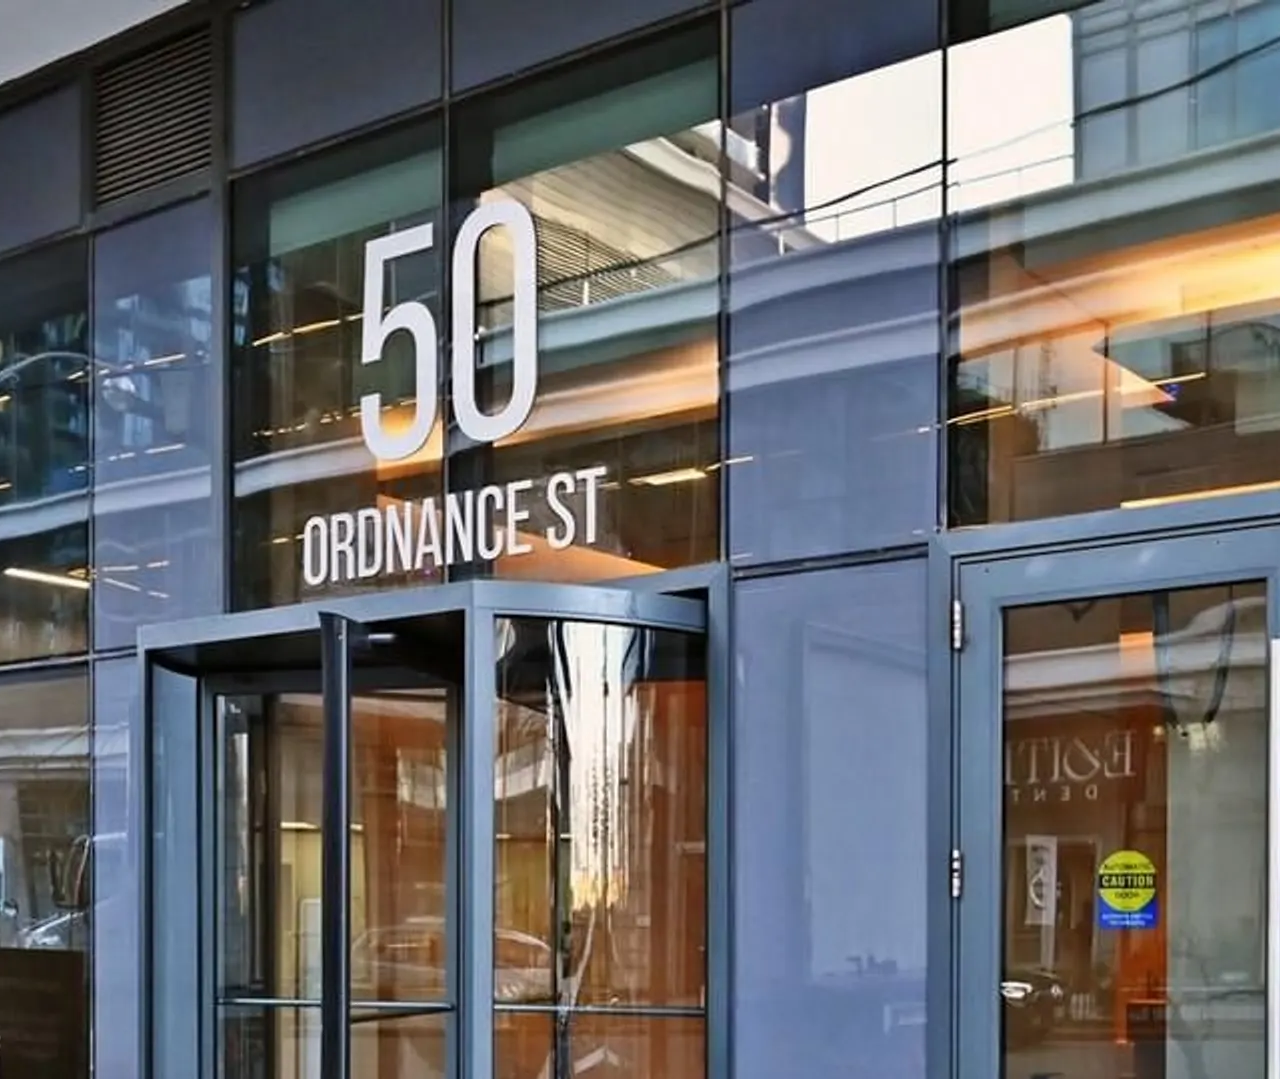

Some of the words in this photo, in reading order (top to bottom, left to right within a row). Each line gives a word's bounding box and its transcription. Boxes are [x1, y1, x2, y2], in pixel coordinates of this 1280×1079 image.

[360, 197, 537, 460] 50
[302, 479, 533, 587] ORDNANCE
[545, 466, 608, 549] ST
[1101, 875, 1154, 888] CAUTION
